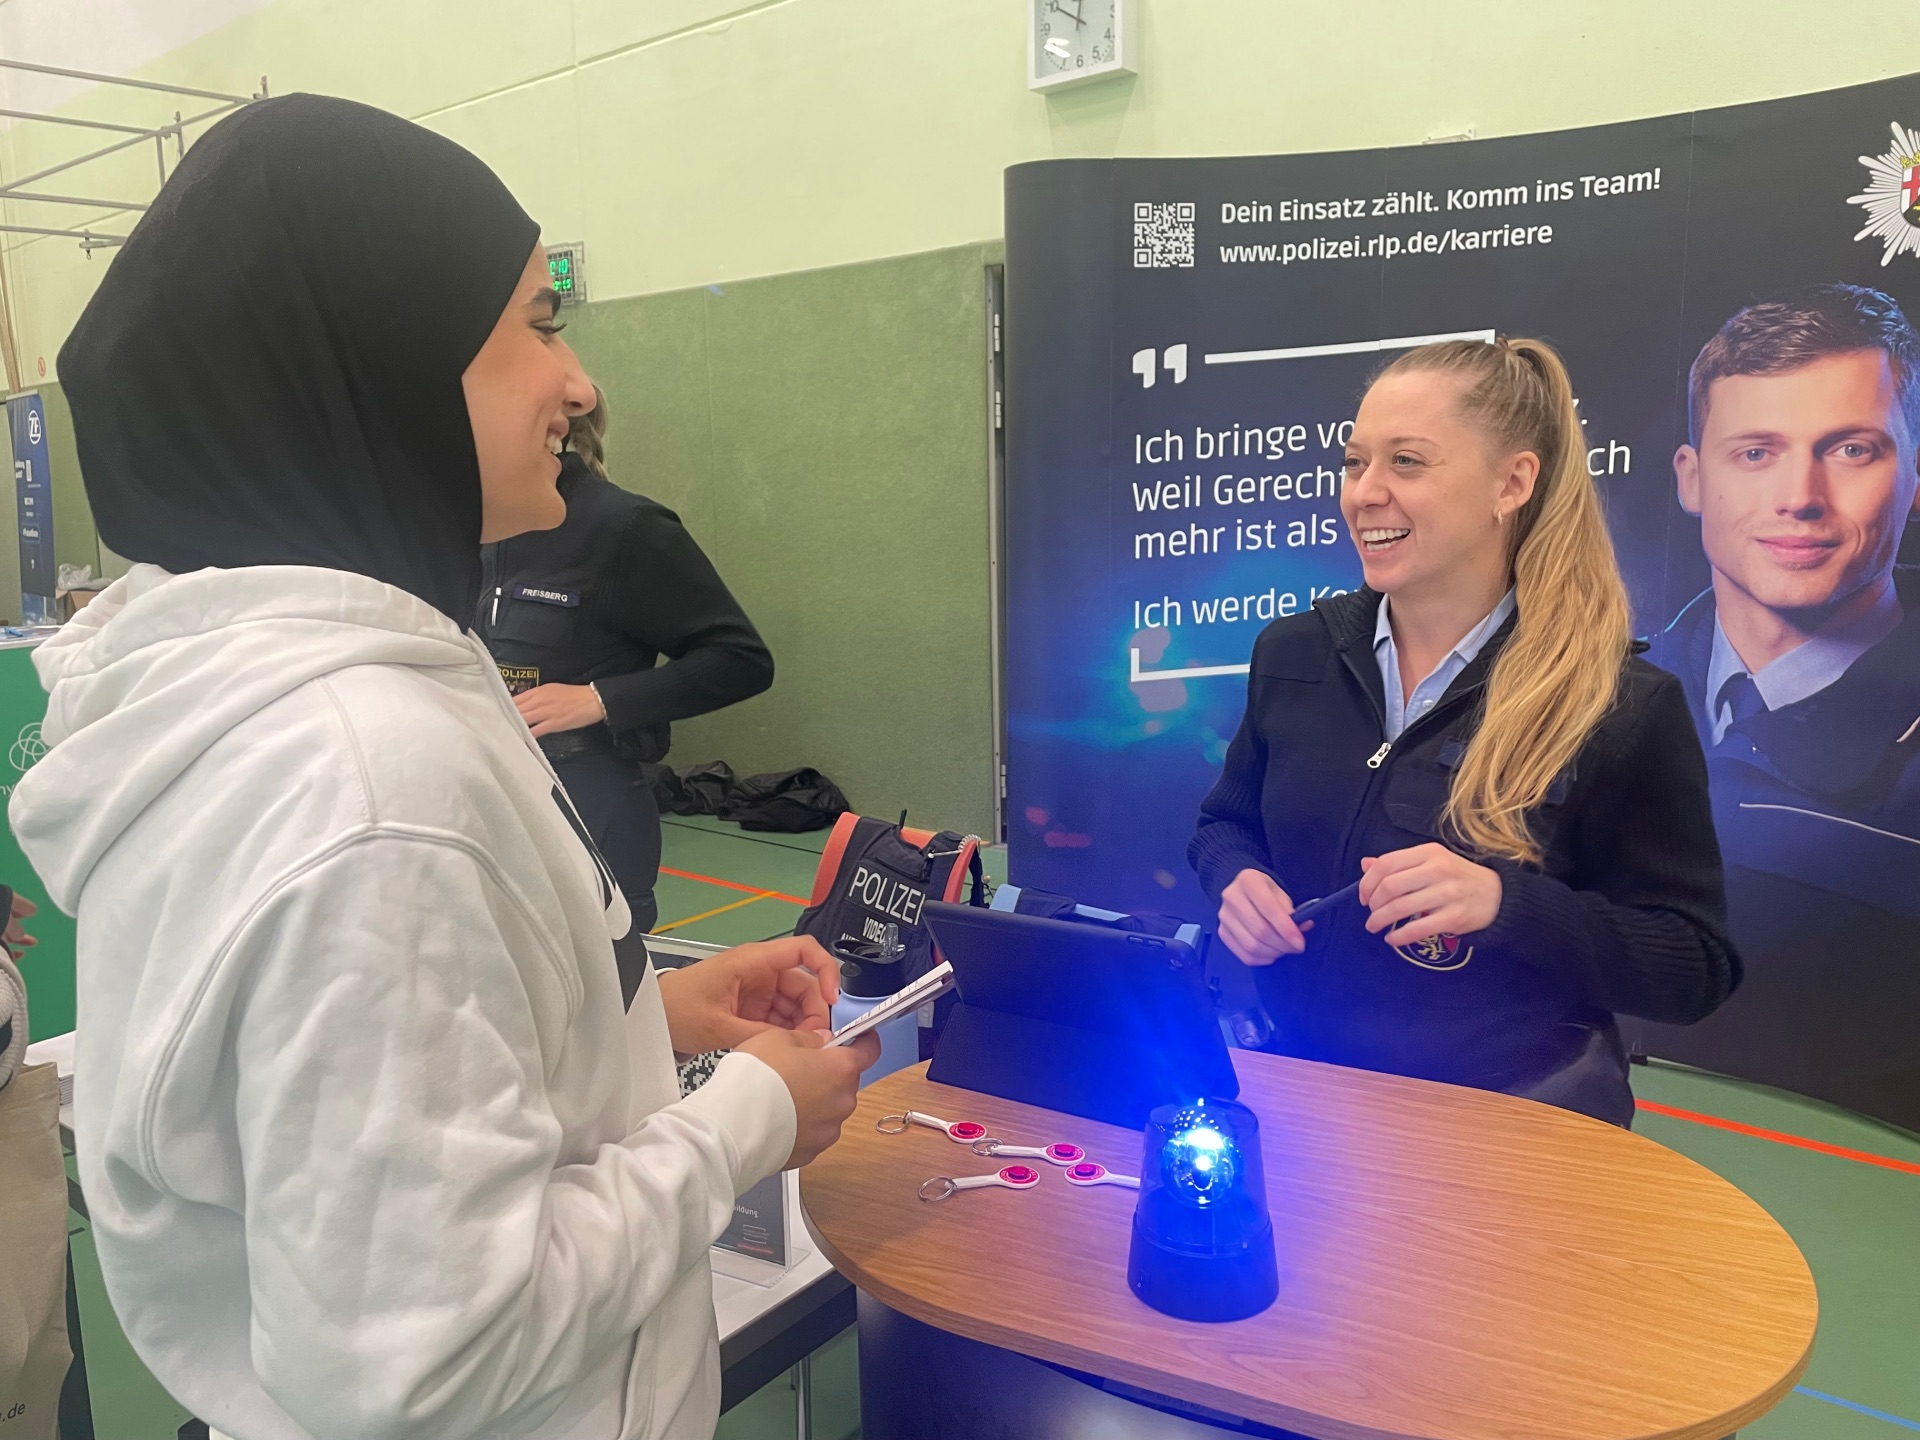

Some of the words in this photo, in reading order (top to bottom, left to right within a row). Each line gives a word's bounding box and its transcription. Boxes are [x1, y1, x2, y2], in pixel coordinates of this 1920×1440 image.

[1076, 54, 1084, 68] 6
[1092, 45, 1100, 59] 5
[1221, 201, 1273, 223] Dein
[1280, 199, 1366, 221] Einsatz
[1371, 190, 1439, 216] zählt.
[1447, 188, 1528, 210] Komm
[1535, 179, 1574, 203] ins
[1580, 167, 1661, 198] Team!
[1220, 224, 1553, 265] www.polizei.rlp.de/karriere
[1135, 429, 1184, 464] Ich
[1196, 423, 1307, 460] bringe
[1132, 475, 1201, 512] Weil
[1135, 523, 1226, 559] mehr
[1236, 519, 1277, 550] ist
[1286, 513, 1338, 547] als
[522, 588, 568, 602] FREISBERG
[1134, 596, 1182, 629] Ich
[1192, 588, 1297, 624] werde
[849, 866, 925, 926] POLIZEI
[0, 1402, 26, 1422] .de
